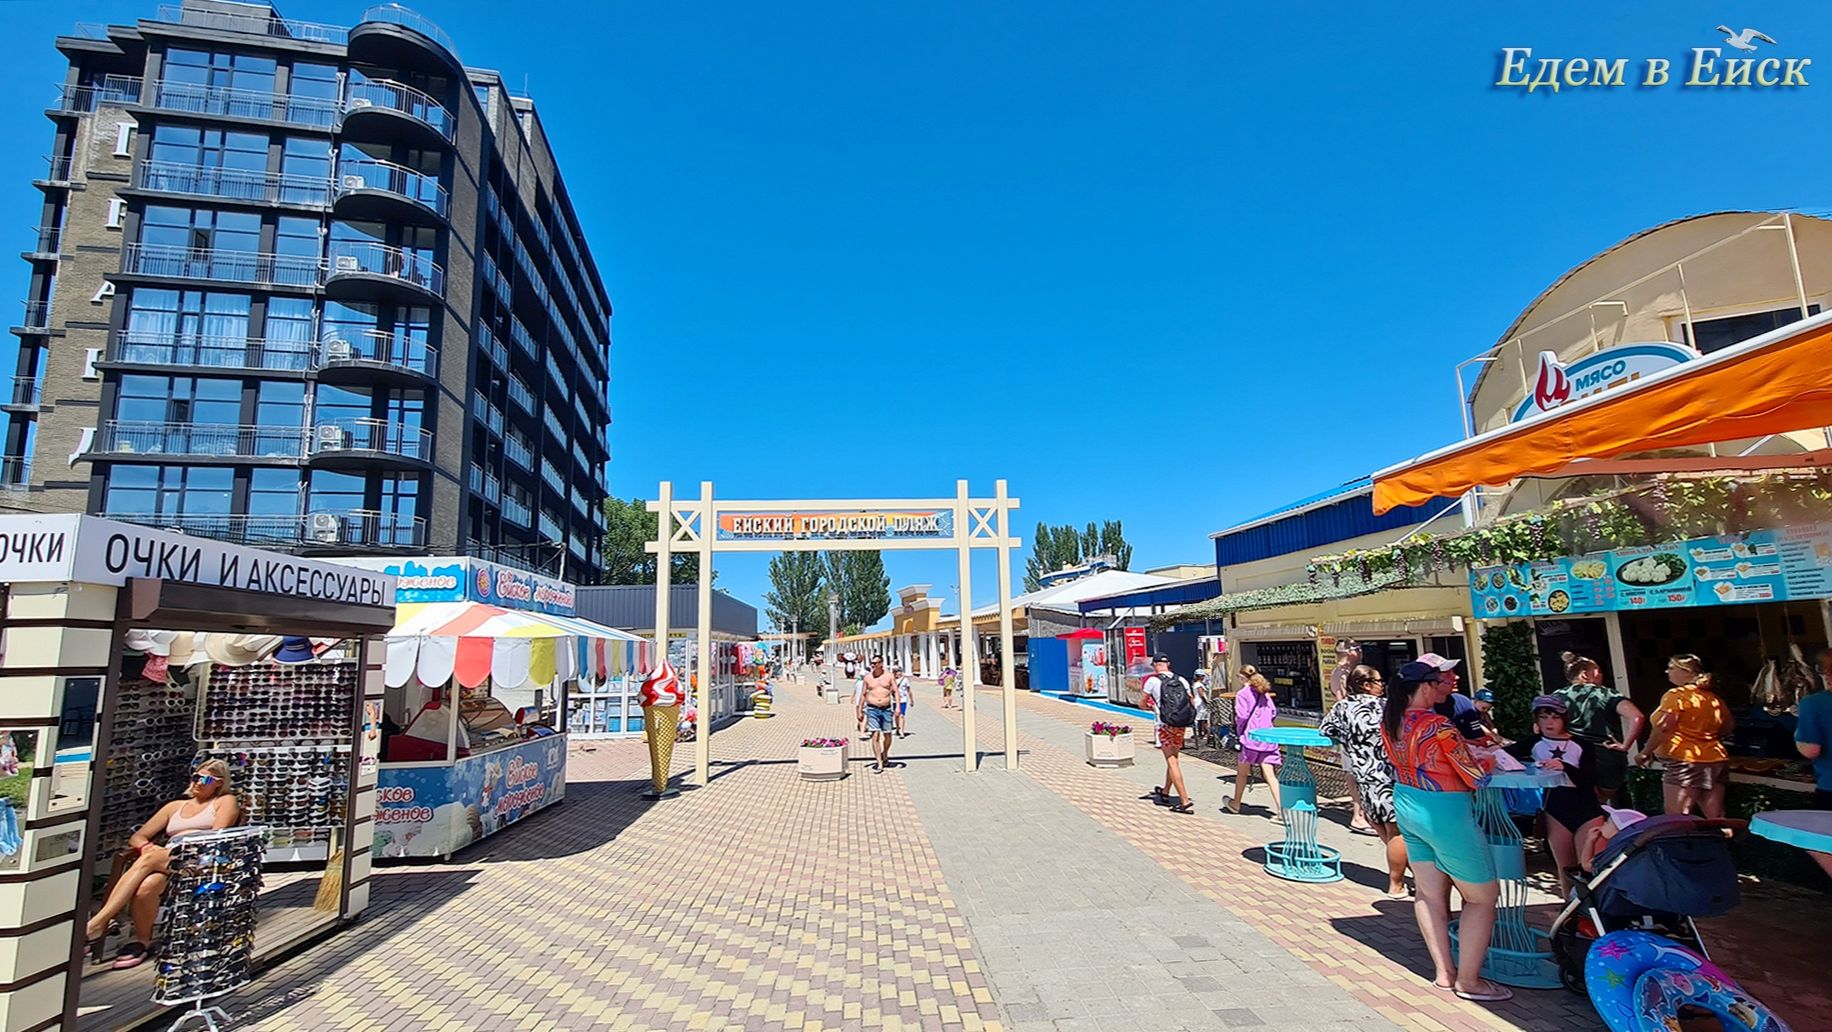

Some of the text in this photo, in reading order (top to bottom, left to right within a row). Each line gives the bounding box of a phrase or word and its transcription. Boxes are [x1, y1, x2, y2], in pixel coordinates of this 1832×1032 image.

[1575, 359, 1627, 392] МЯСО
[733, 514, 940, 533] ЕЙСКИЙ ГОРОДСКОЙ ПЛЯЖ
[105, 533, 386, 607] ОЧКИ И АКСЕССУАРЫ
